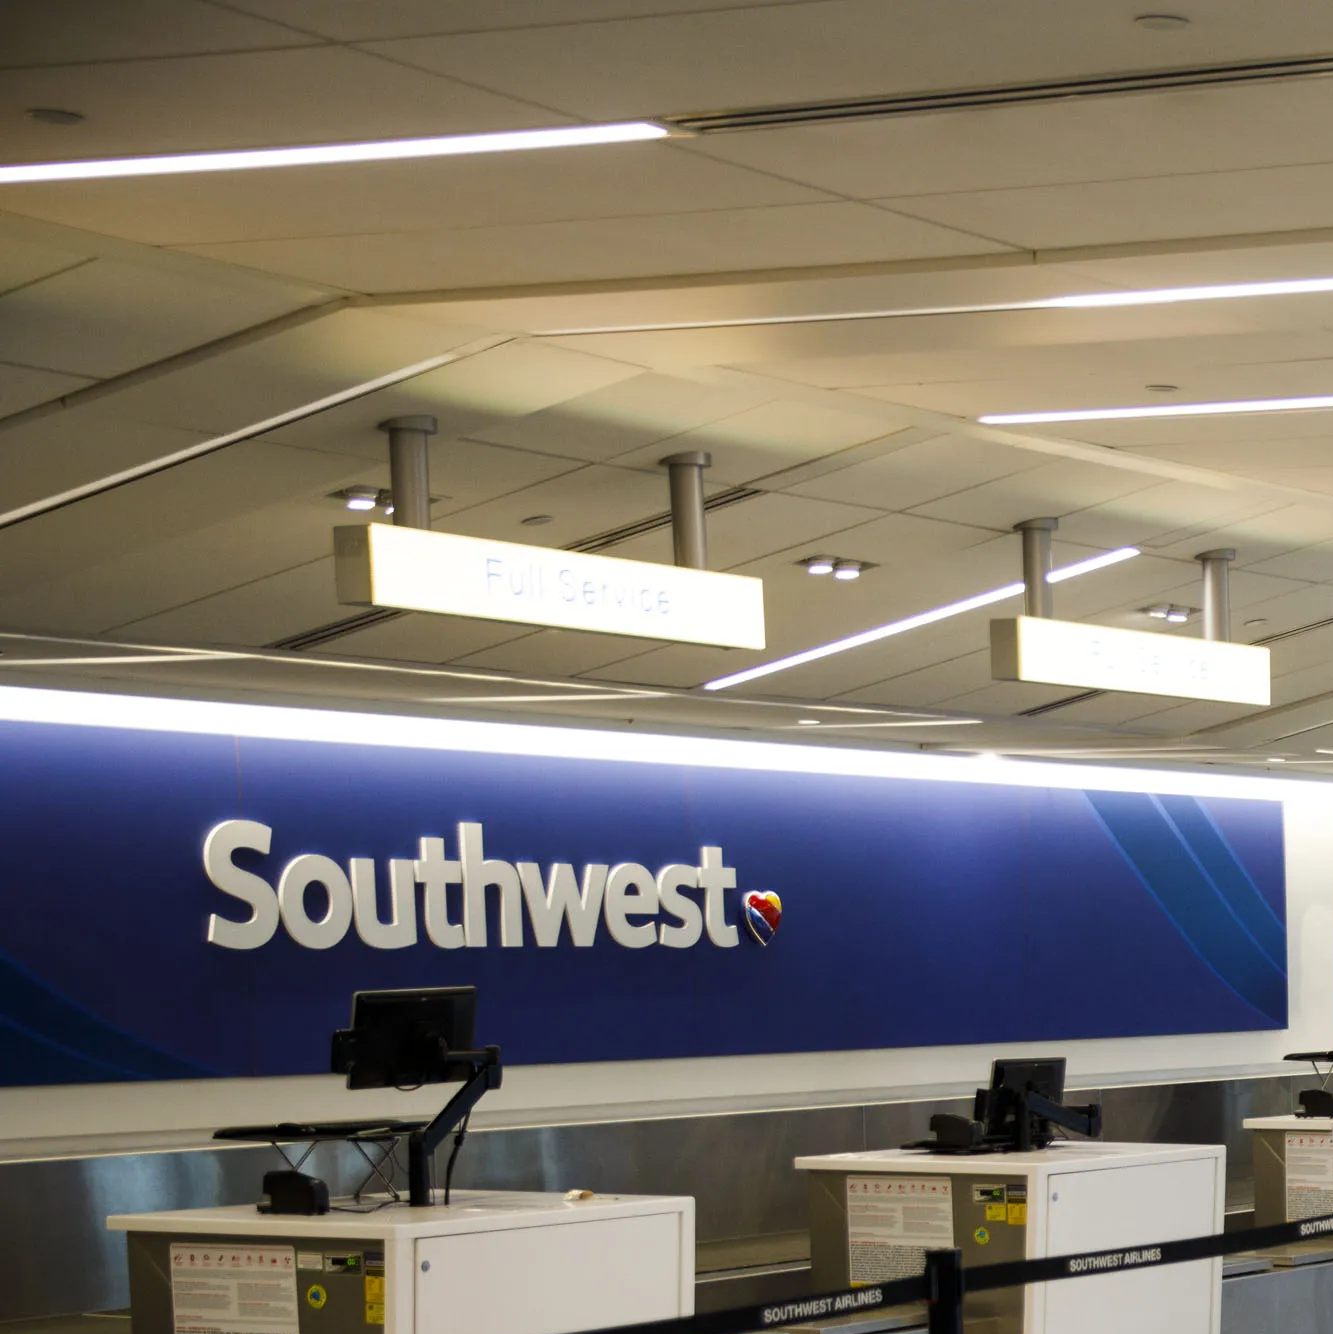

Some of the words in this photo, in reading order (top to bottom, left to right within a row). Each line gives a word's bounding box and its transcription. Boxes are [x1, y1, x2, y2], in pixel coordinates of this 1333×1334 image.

[486, 557, 543, 598] Full
[558, 568, 670, 614] Service
[203, 819, 739, 949] Southwest
[1069, 1253, 1123, 1272] SOUTHWEST
[1124, 1247, 1162, 1265] AIRLINES
[764, 1298, 832, 1324] SOUTHWEST
[834, 1288, 883, 1310] AIRLINES
